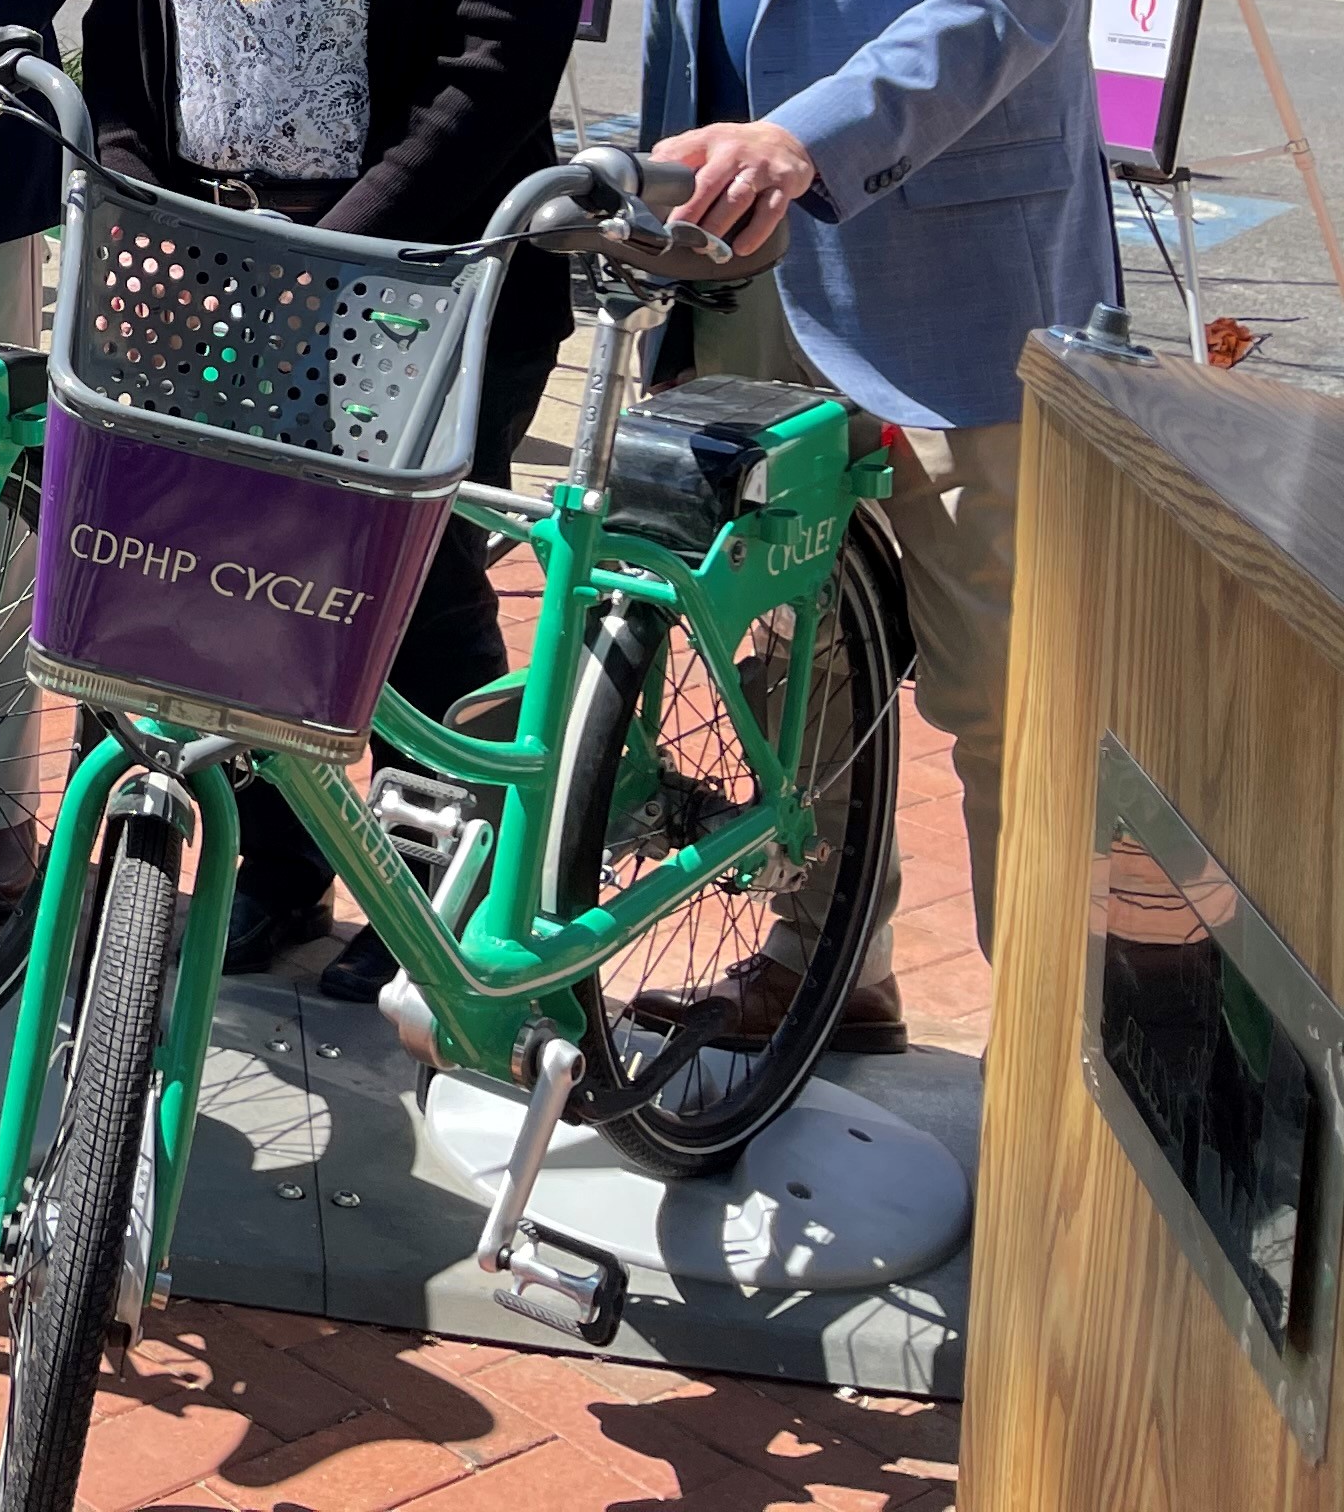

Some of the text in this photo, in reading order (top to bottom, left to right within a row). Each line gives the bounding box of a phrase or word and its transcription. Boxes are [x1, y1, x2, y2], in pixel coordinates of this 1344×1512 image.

[590, 374, 603, 389] 2
[585, 407, 597, 423] 3
[579, 439, 592, 455] 4
[69, 521, 367, 626] CDPHP CYCLE!
